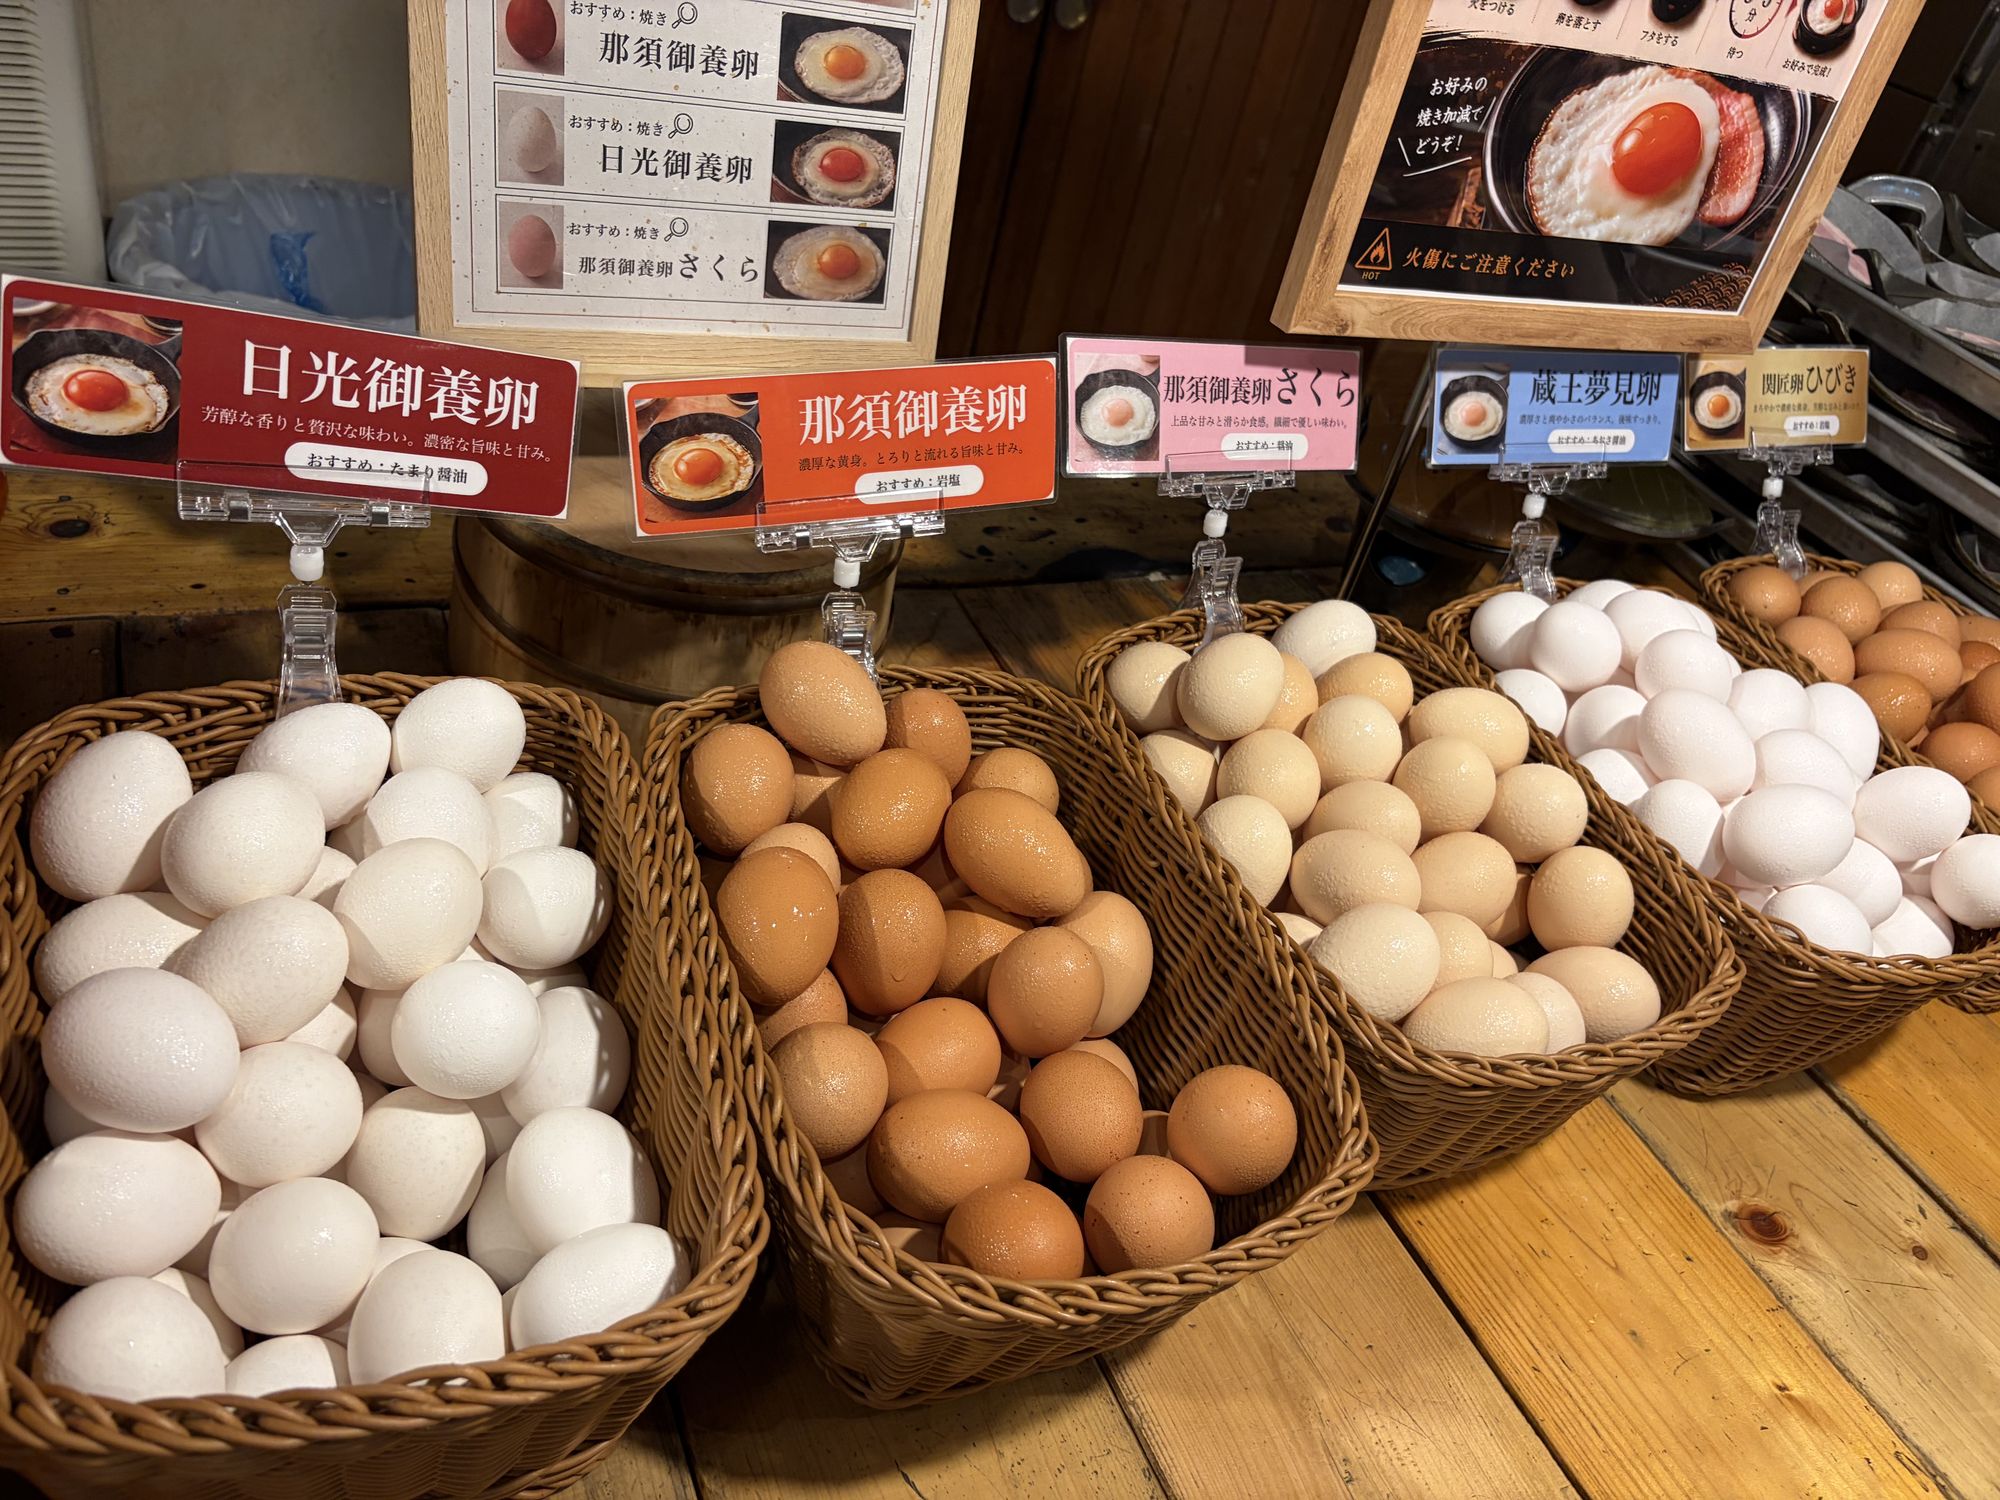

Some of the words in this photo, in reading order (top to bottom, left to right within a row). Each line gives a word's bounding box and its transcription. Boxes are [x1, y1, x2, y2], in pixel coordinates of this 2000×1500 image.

[1555, 12, 1602, 32] 卵を落とす
[1640, 30, 1680, 47] フタをする
[599, 30, 760, 81] 那須御養卵
[1726, 46, 1744, 60] 待つ
[1429, 76, 1488, 97] お好みの
[1415, 105, 1485, 128] 焼き加減で
[601, 143, 753, 185] 日光御養卵
[1402, 246, 1576, 277] 火傷にご注意ください
[1361, 271, 1381, 281] HOT
[241, 338, 540, 431] 日光御養卵
[1528, 368, 1663, 407] 蔵王夢見卵
[798, 383, 1028, 446] 那須御養卵
